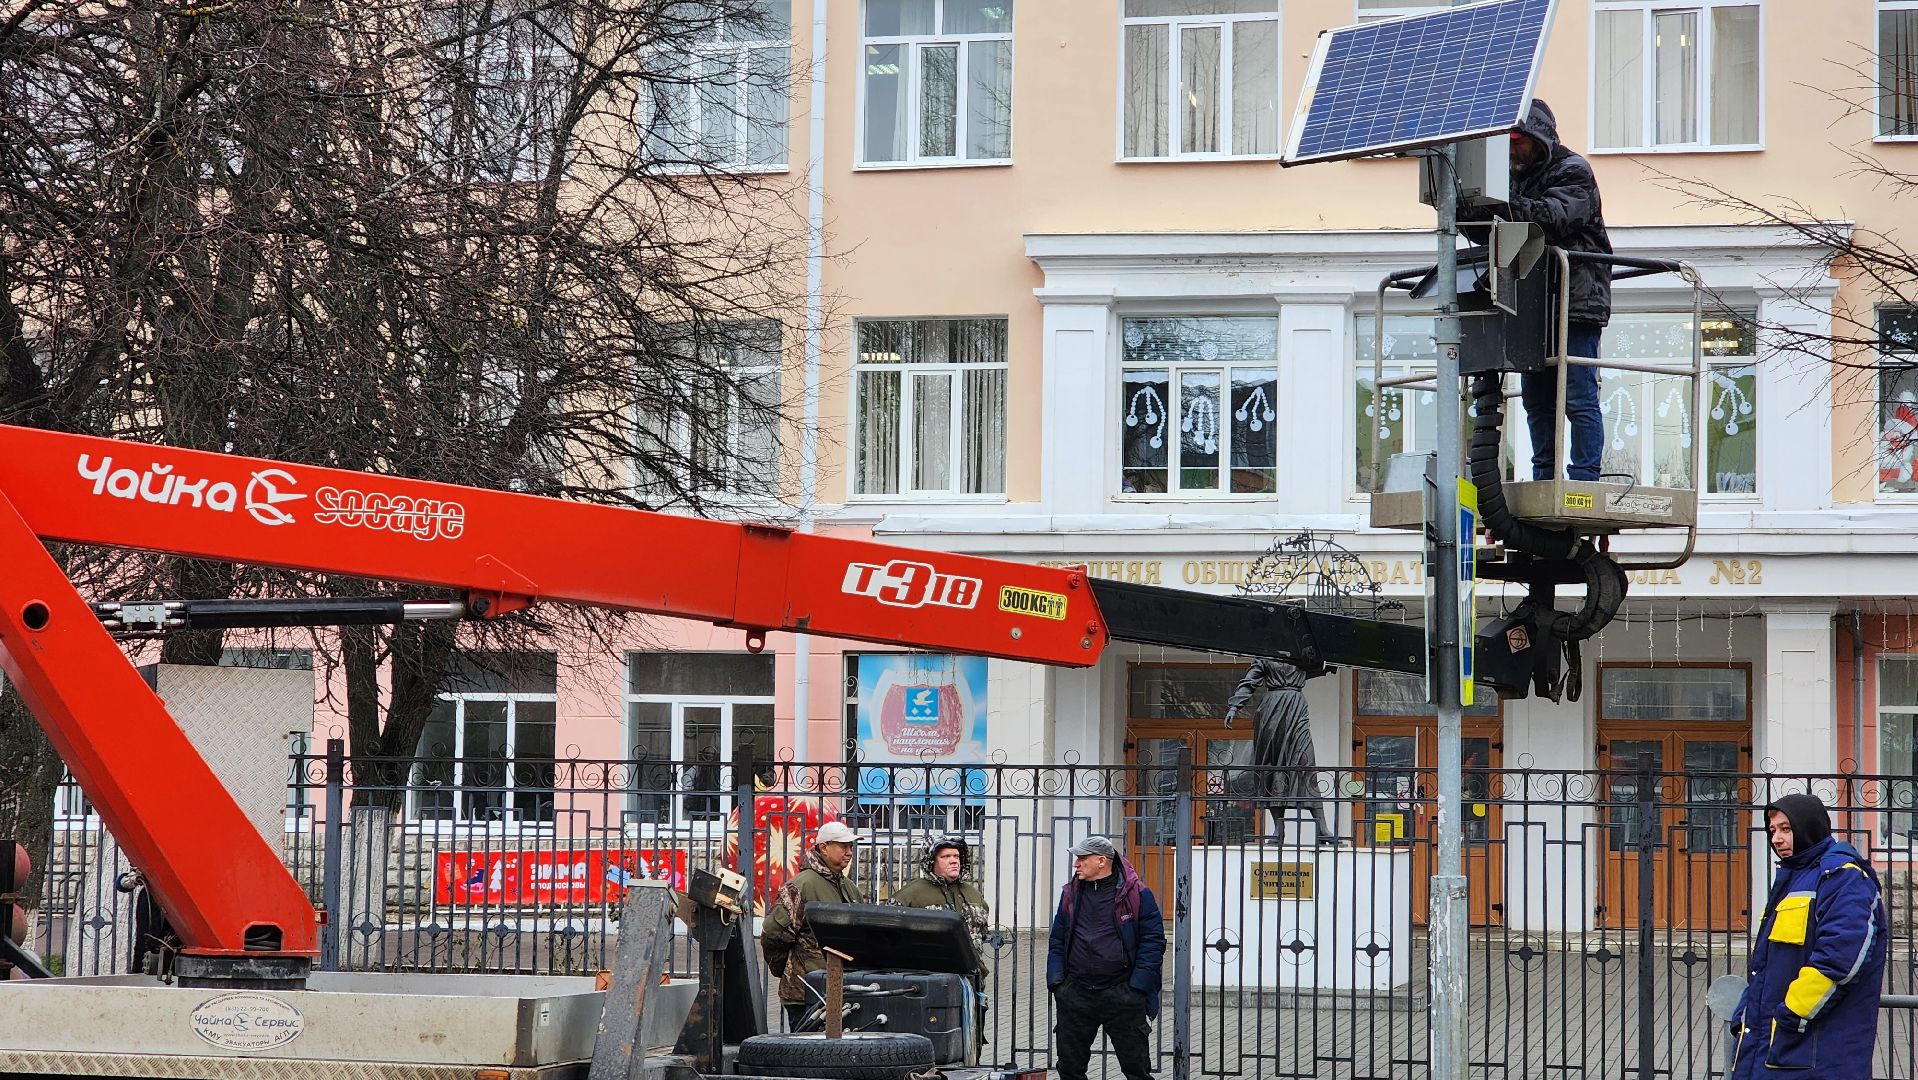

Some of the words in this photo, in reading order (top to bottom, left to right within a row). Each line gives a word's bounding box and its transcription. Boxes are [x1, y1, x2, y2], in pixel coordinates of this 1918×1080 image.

[77, 453, 237, 512] Чайка
[314, 486, 465, 541] socage
[1036, 560, 1162, 585] ДНЯЯ
[1710, 560, 1762, 584] №2
[901, 728, 940, 737] Школа,
[530, 862, 587, 880] ЗИМА
[194, 1014, 232, 1025] Чайка
[255, 1016, 299, 1029] Сервис
[203, 1027, 222, 1040] КМУ
[224, 1039, 270, 1048] ЭВАКУАТОРЫ
[274, 1029, 290, 1042] АГП
